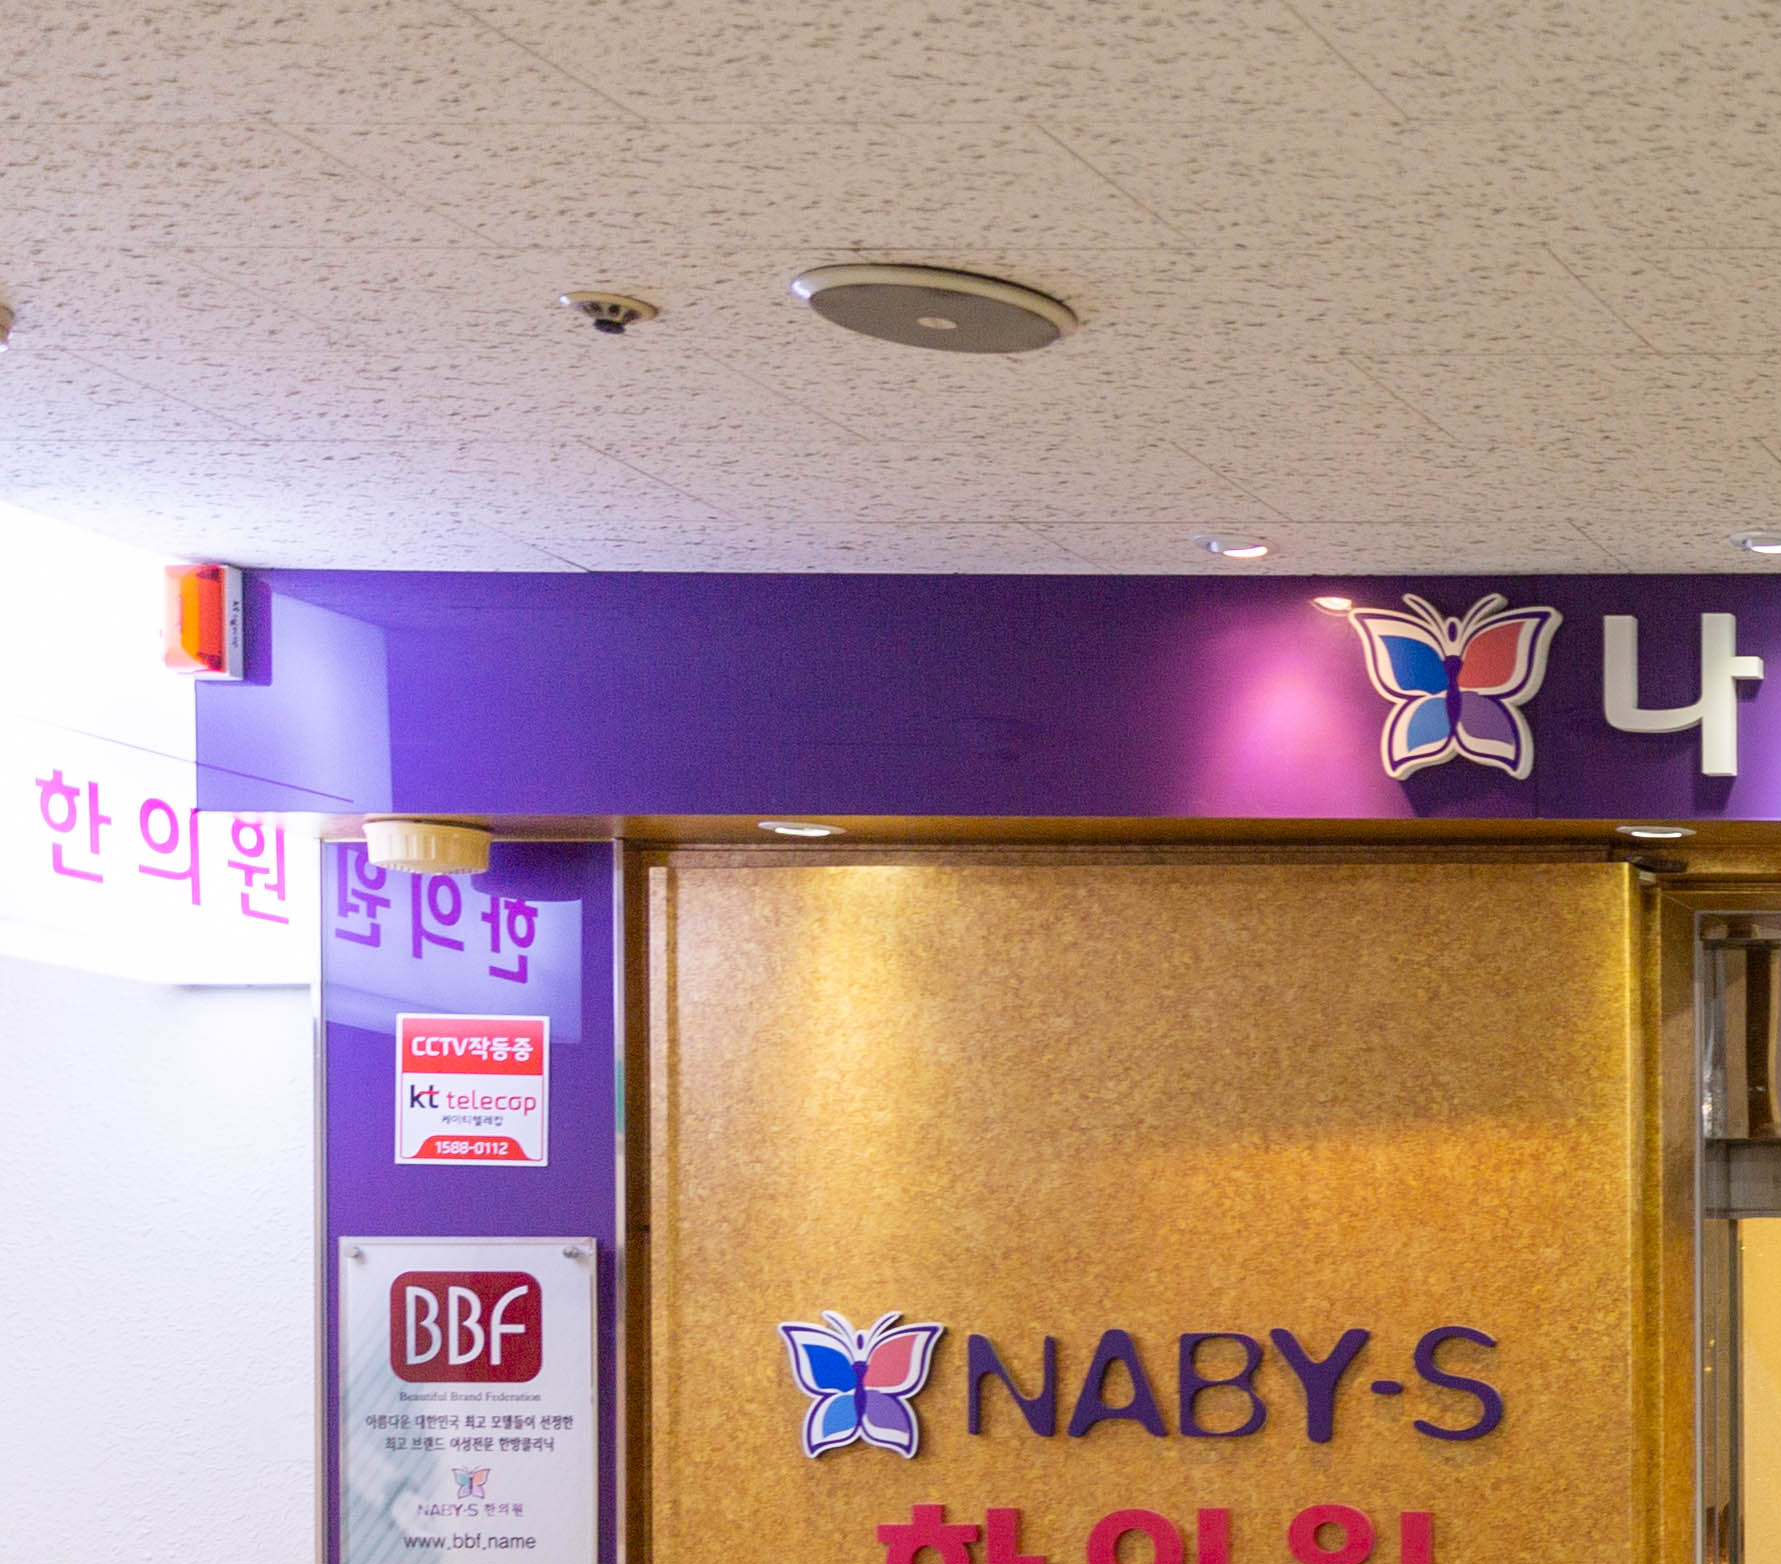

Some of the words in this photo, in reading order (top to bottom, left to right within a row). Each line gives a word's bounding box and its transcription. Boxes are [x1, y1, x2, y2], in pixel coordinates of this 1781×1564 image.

[35, 769, 289, 925] 한의원
[411, 1036, 533, 1061] CCTV작동중
[410, 1085, 439, 1108] kt
[446, 1090, 536, 1115] telecop
[435, 1141, 508, 1154] 1588-0112
[405, 1285, 529, 1366] BBF
[400, 1392, 448, 1402] Beautiful
[451, 1392, 482, 1401] Brand
[486, 1392, 541, 1401] Federation
[967, 1326, 1504, 1444] NABY-S
[404, 1533, 536, 1551] www.bbf.name
